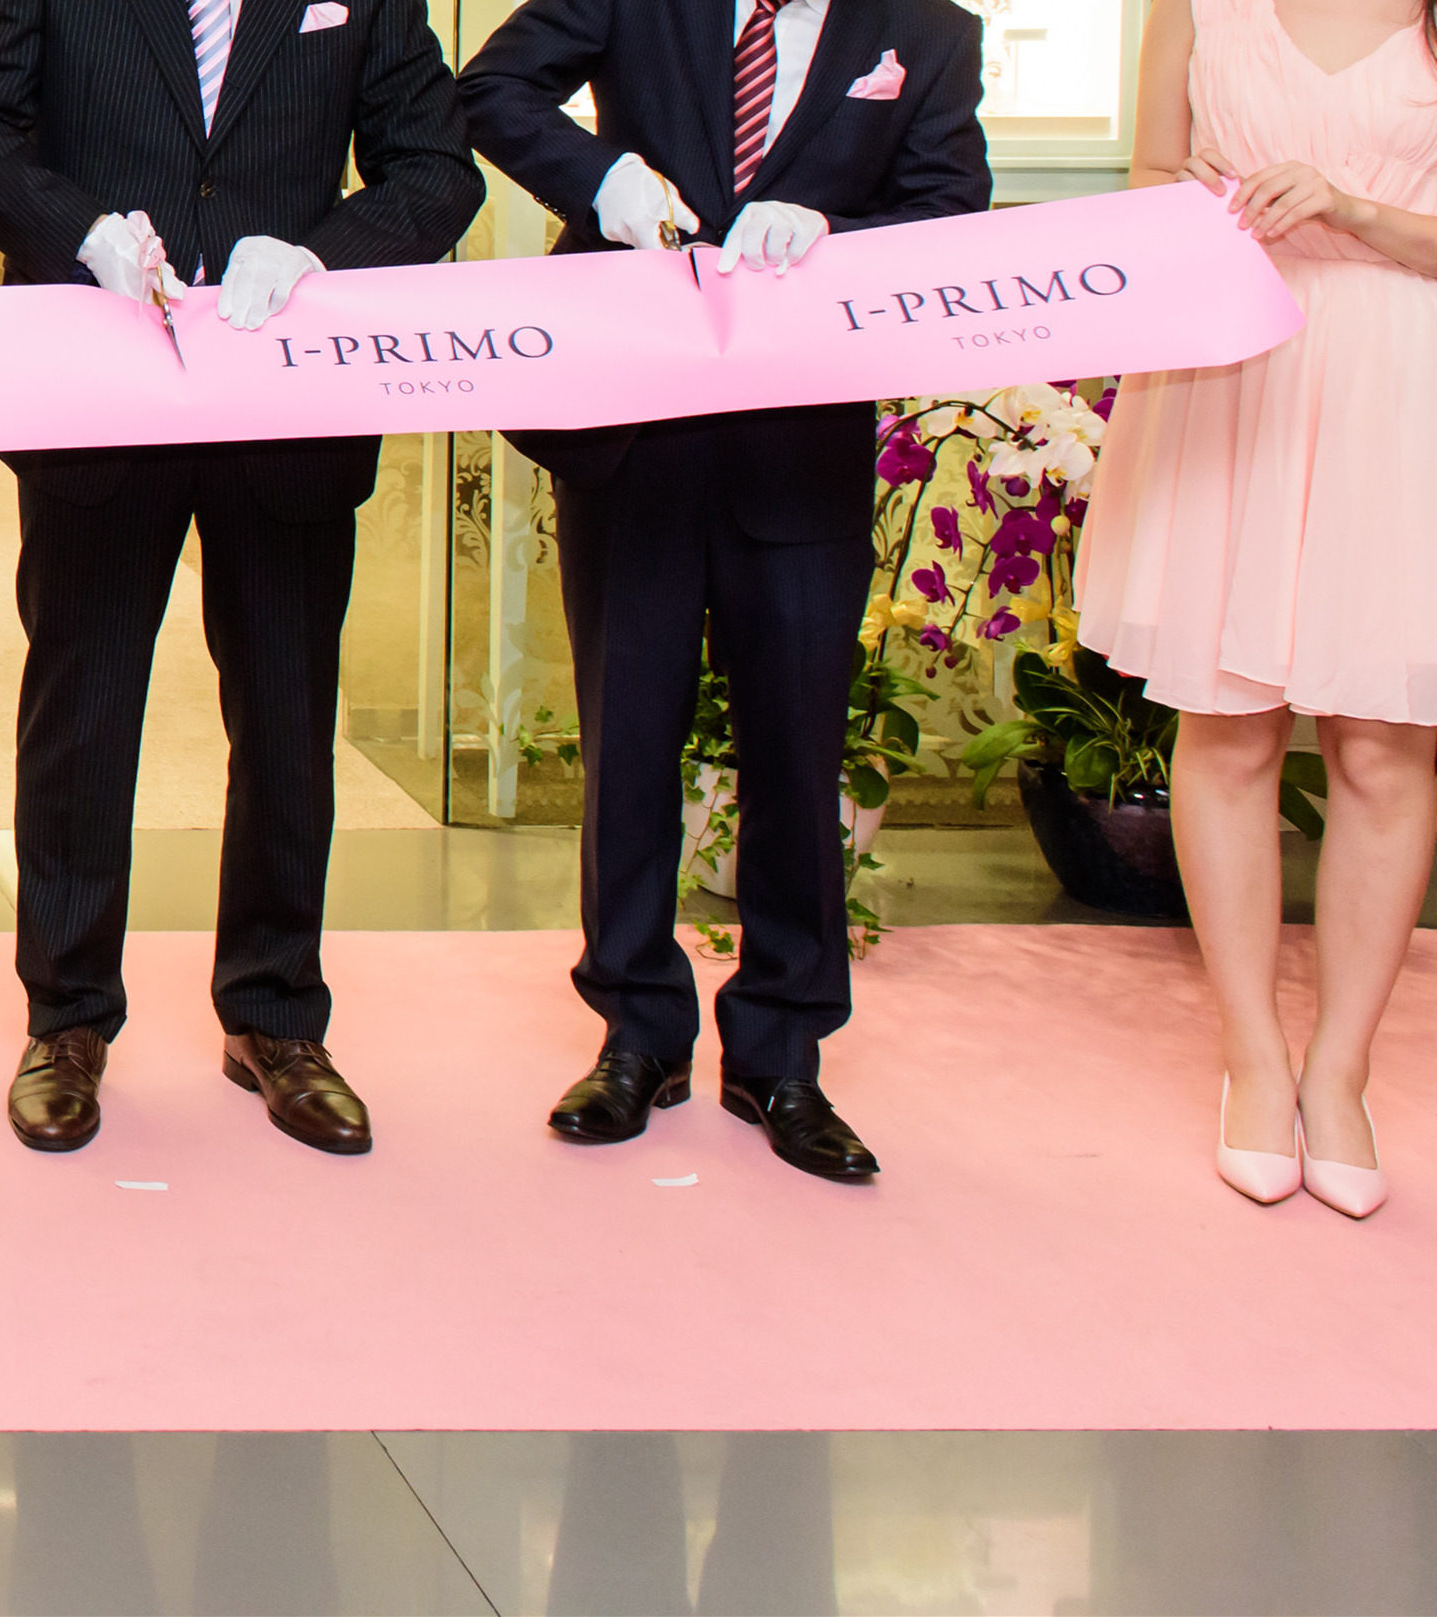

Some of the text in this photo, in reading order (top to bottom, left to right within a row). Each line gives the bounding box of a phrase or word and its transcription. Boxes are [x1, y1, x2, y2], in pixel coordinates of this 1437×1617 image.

[837, 263, 1128, 331] I-PRIMO
[275, 325, 554, 368] I-PRIMO
[951, 325, 1051, 351] TOKYO
[379, 379, 475, 396] TOKYO
